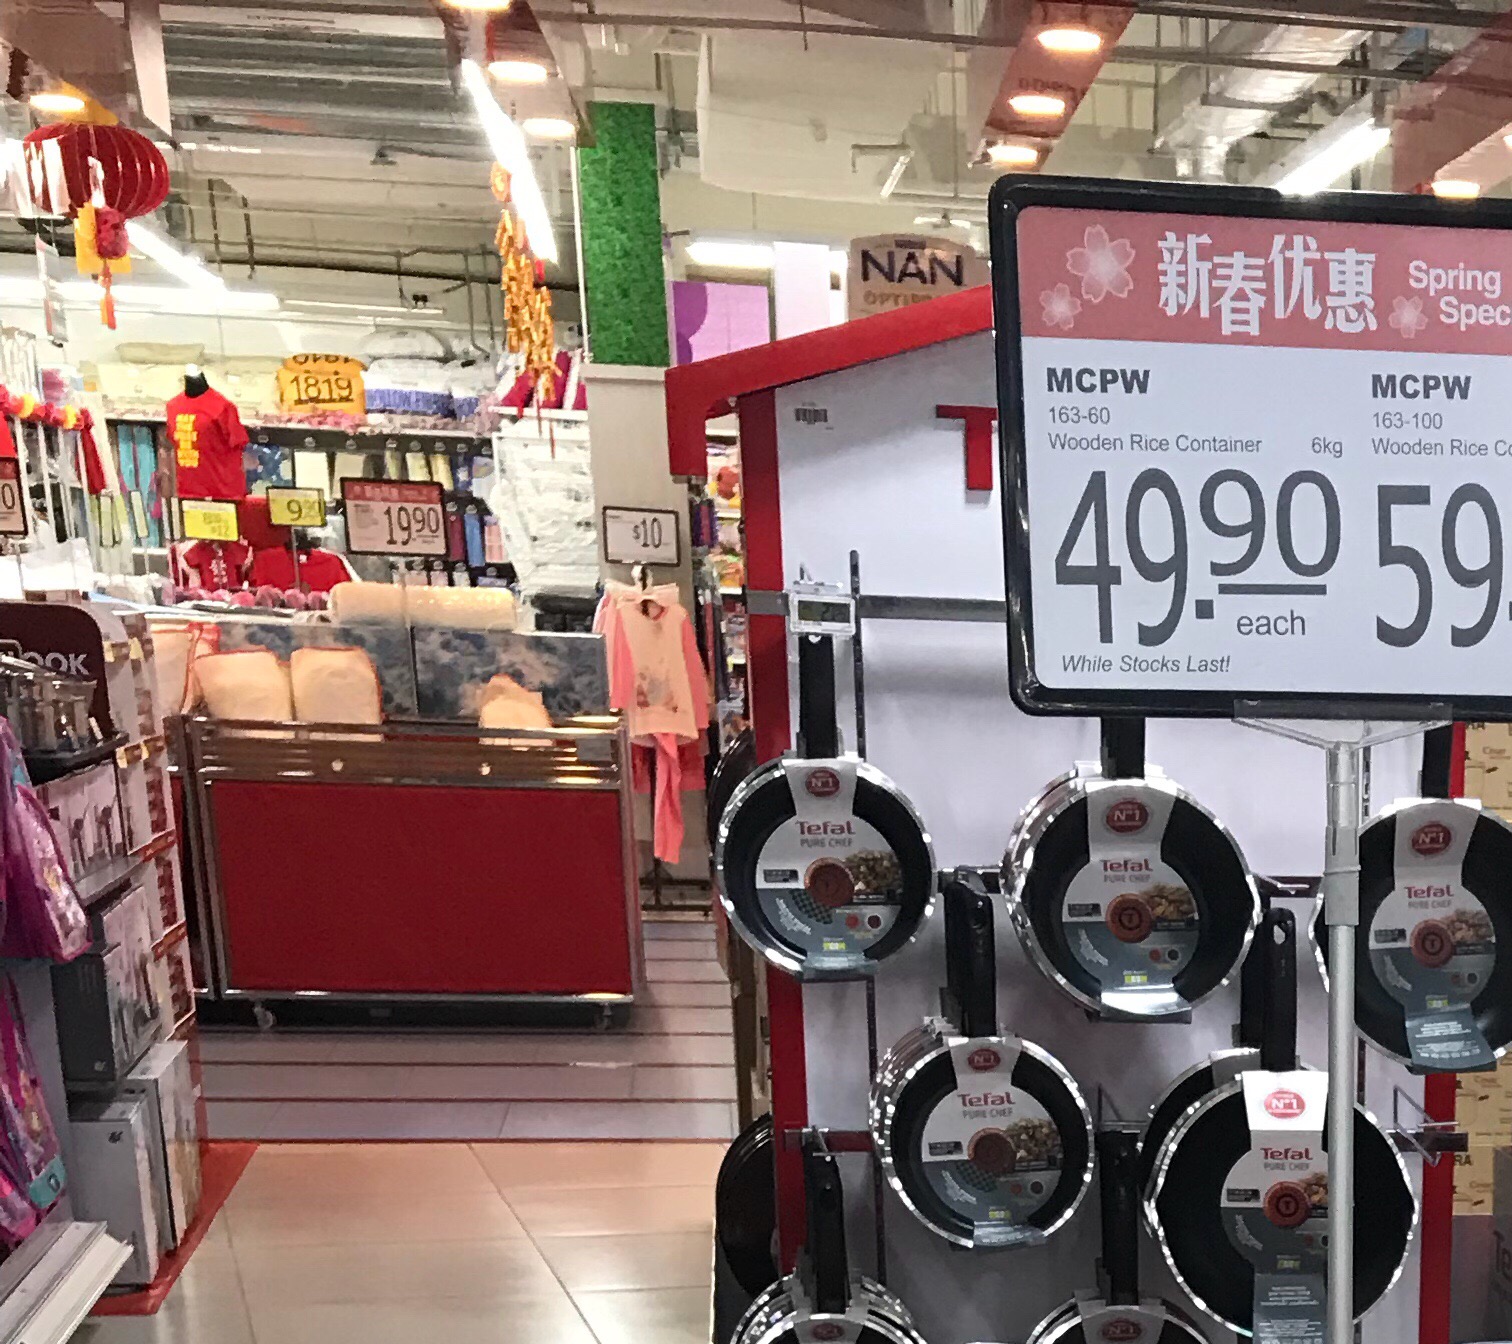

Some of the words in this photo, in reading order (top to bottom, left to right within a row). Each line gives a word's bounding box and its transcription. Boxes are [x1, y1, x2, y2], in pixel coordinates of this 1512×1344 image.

[1157, 230, 1377, 336] 新春优惠
[1407, 259, 1502, 298] Spring
[1046, 367, 1151, 394] MCPW
[1371, 373, 1472, 400] MCPW
[1048, 406, 1111, 425] 163-60
[1371, 411, 1443, 430] 163-100
[1047, 432, 1124, 451] Wooden
[1130, 433, 1170, 452] Rice
[1175, 434, 1263, 453] Container
[1310, 436, 1344, 459] 6kg
[1371, 436, 1444, 456] Wooden
[1450, 437, 1489, 457] Rice
[1054, 467, 1342, 648] 49.90
[1236, 609, 1306, 636] each
[1062, 654, 1113, 673] While
[1119, 655, 1181, 673] Stocks
[1186, 655, 1232, 674] Last!
[795, 819, 856, 836] Tefal
[1100, 857, 1154, 873] Tefal
[1404, 883, 1455, 900] Tefal
[956, 1091, 1016, 1108] Tefal
[1259, 1147, 1314, 1161] Tefal
